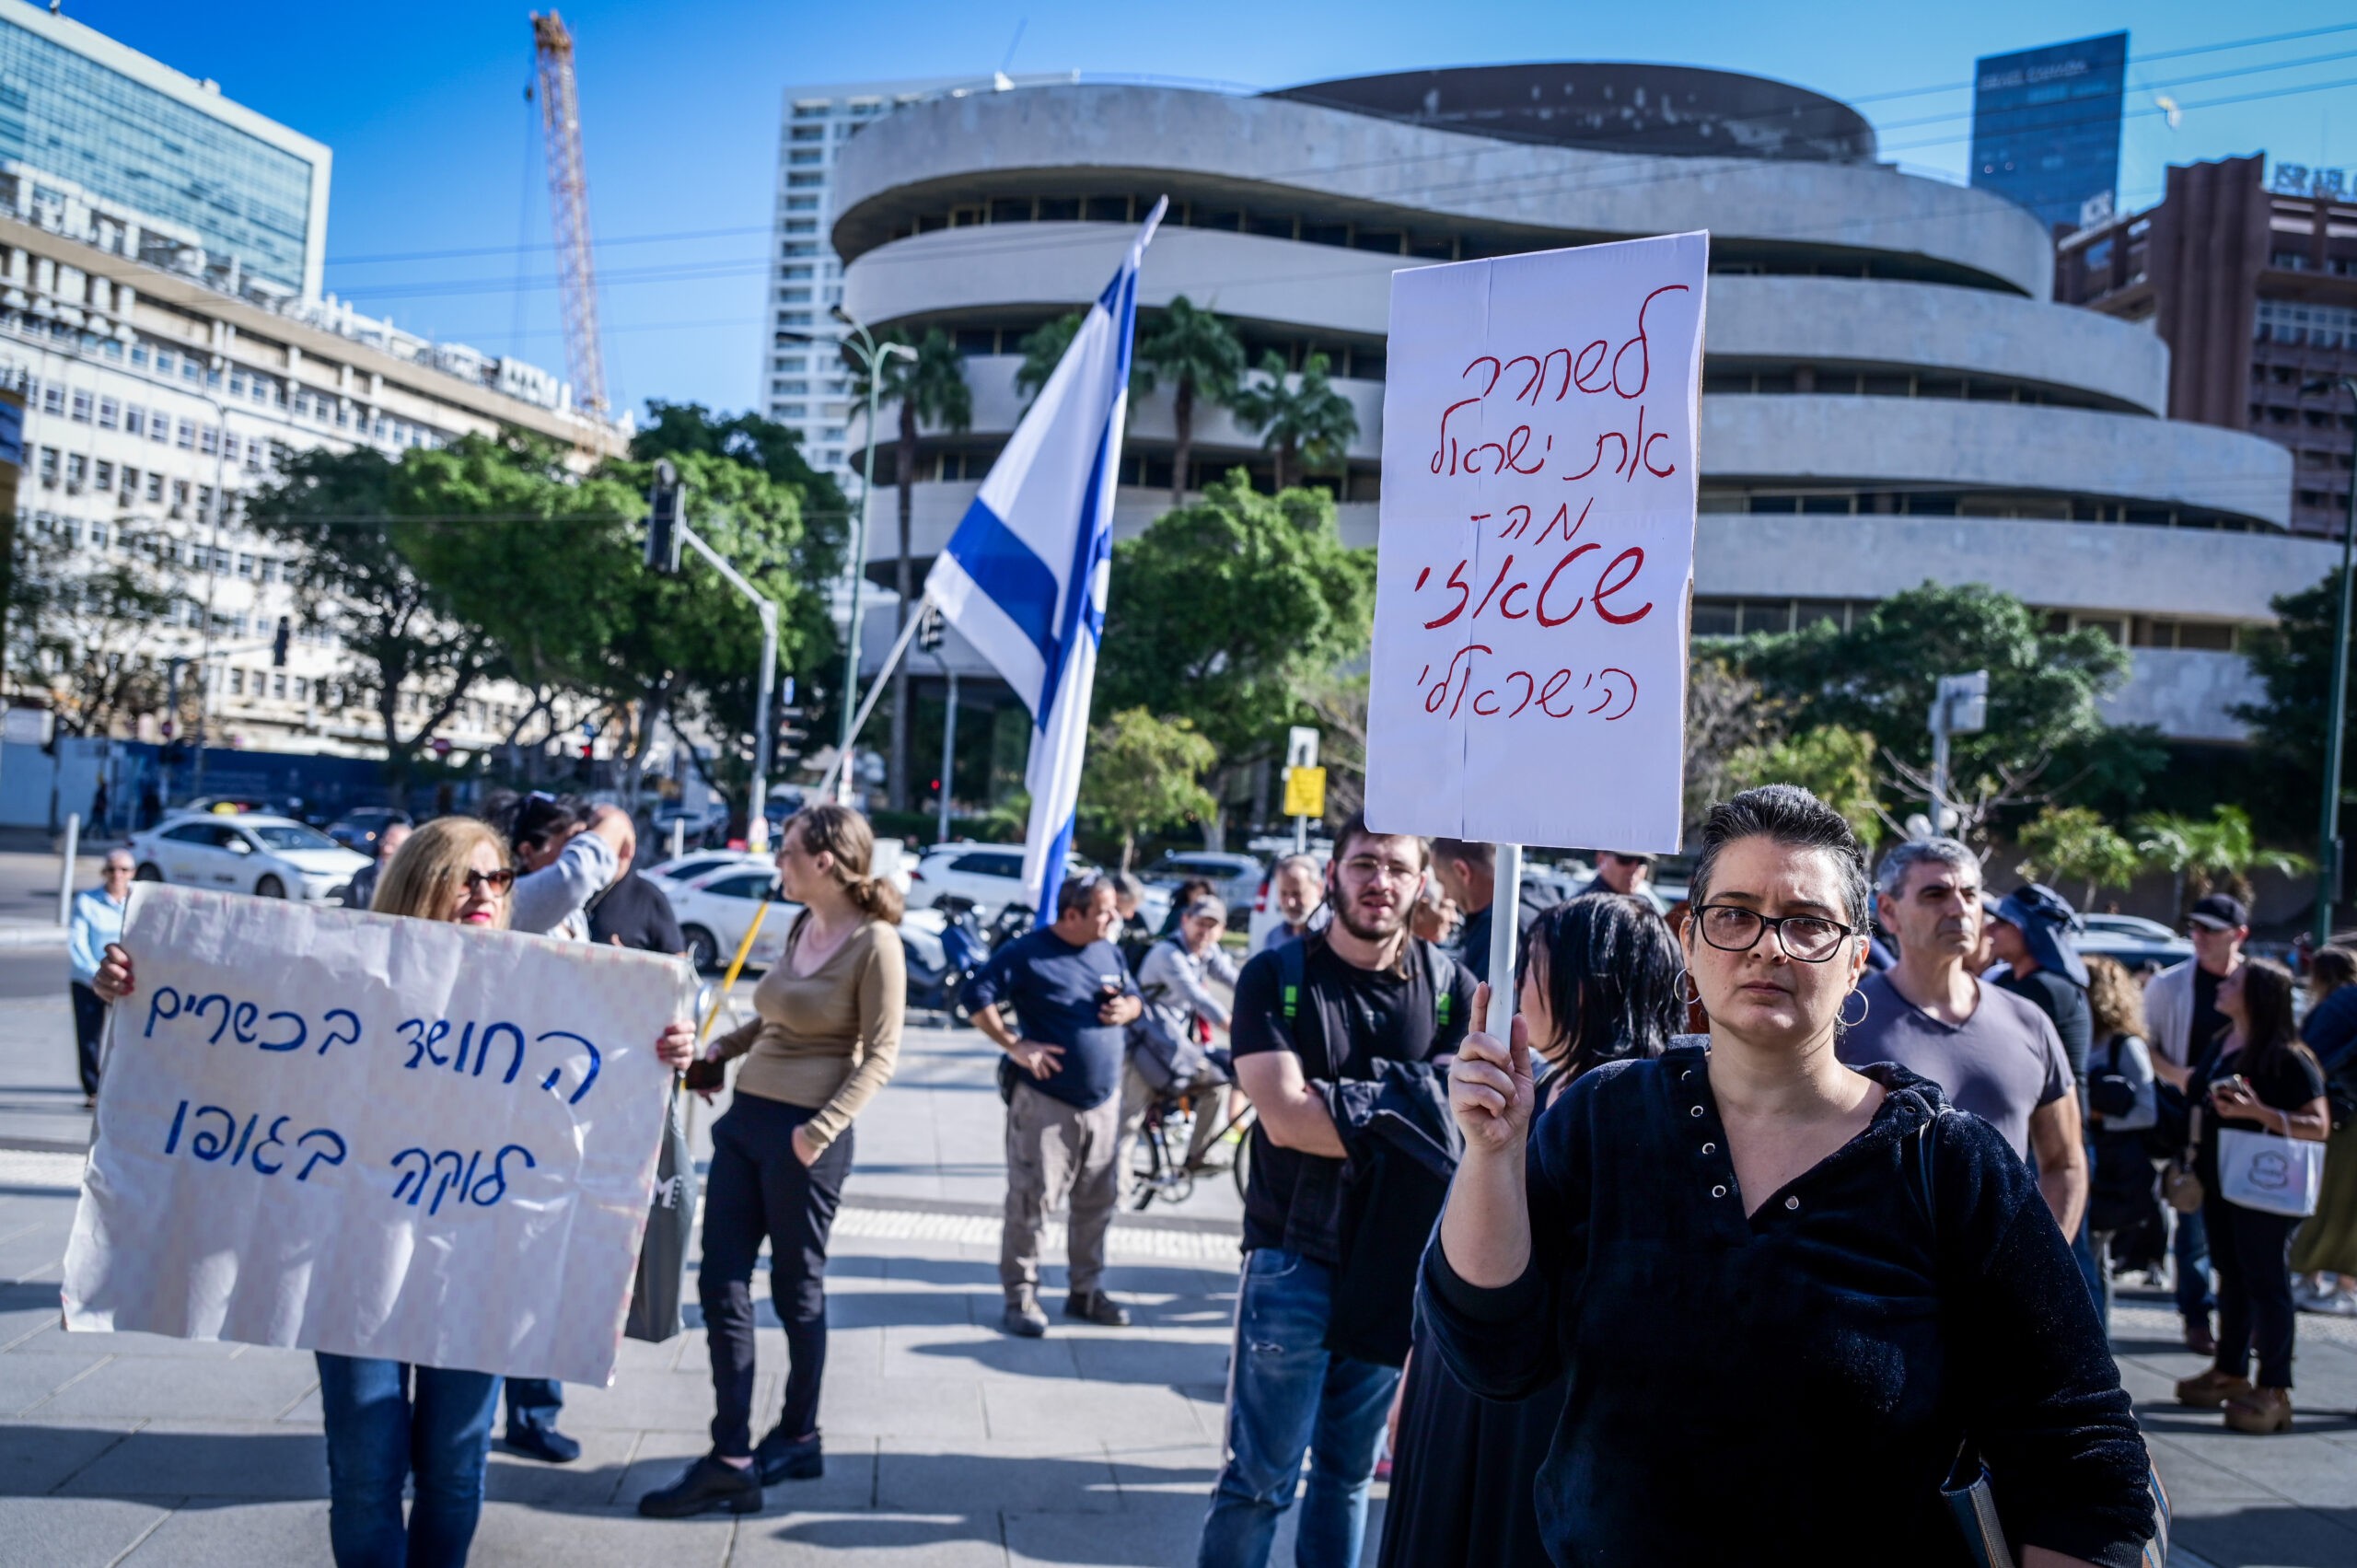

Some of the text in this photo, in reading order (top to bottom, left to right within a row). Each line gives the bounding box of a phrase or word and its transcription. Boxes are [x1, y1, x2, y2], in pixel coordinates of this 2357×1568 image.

[1462, 285, 1689, 407] לשחרר
[1430, 397, 1676, 482] את ישראל
[1414, 542, 1654, 630] שטאזי
[1416, 645, 1638, 721] הישראלי
[143, 985, 602, 1106] החושד בכשרים
[163, 1099, 536, 1216] לוקה בגופו
